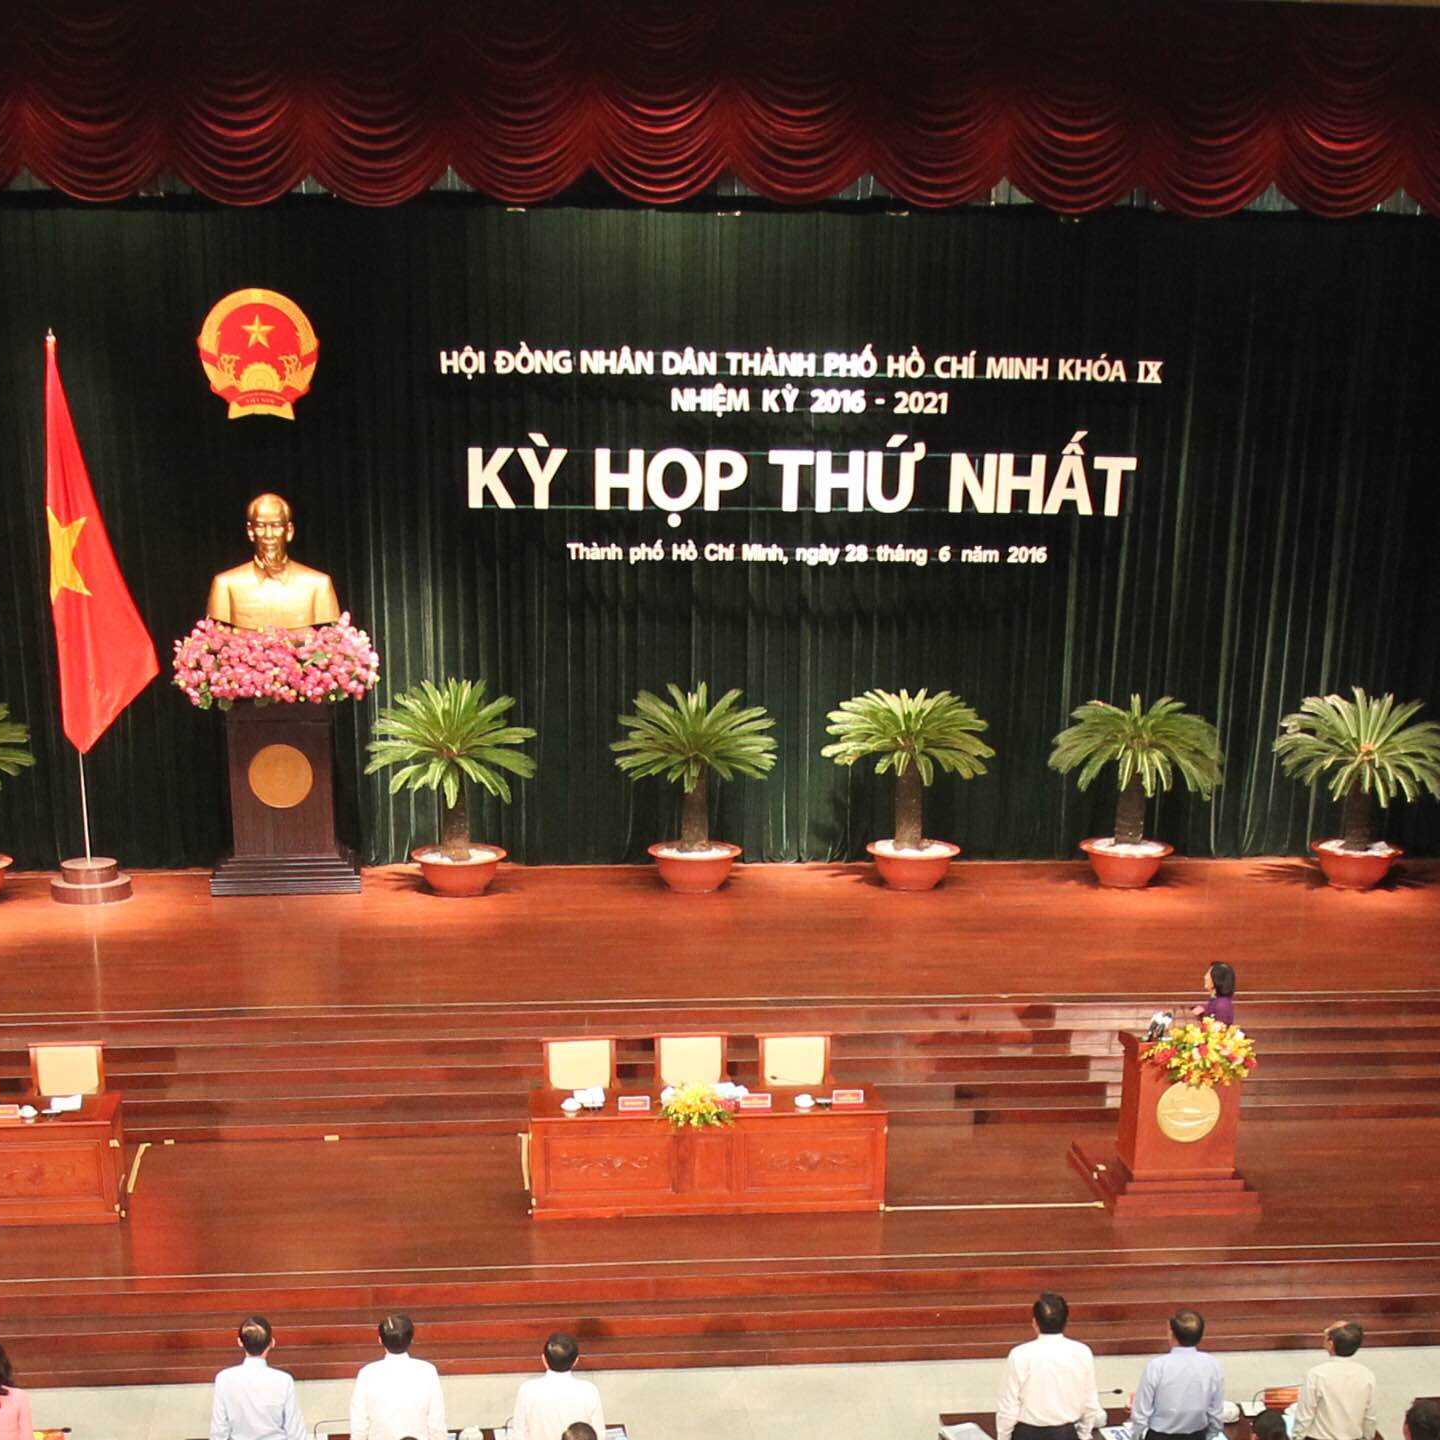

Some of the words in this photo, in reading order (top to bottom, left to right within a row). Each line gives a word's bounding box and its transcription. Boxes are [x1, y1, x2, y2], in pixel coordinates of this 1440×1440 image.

[440, 345, 486, 380] HỘI
[494, 341, 573, 375] ĐỒNG
[580, 346, 655, 375] NHÂN
[662, 347, 718, 376] DÂN
[725, 346, 815, 377] THÀNH
[823, 343, 878, 378] PHỐ
[887, 346, 926, 379] HỒ
[934, 351, 977, 379] CHÍ
[985, 357, 1049, 380] MINH
[1058, 353, 1127, 382] KHÓA
[1137, 361, 1164, 384] IX
[671, 383, 750, 418] NHIỆM
[762, 383, 800, 414] KỲ
[810, 388, 867, 414] 2016
[893, 391, 949, 415] 2021
[468, 432, 568, 510] KỲ
[594, 447, 748, 528] HỌP
[767, 433, 926, 514] THỨ
[948, 430, 1138, 517] NHẤT
[567, 542, 623, 561] Thành
[629, 539, 665, 565] phố
[671, 539, 699, 562] Hồ
[704, 543, 736, 562] Chí
[742, 544, 789, 565] Minh,
[795, 543, 841, 567] ngày
[845, 544, 869, 562] 28
[876, 544, 928, 567] tháng
[938, 546, 952, 562] 6
[961, 545, 1000, 563] năm
[1007, 546, 1048, 563] 2016
